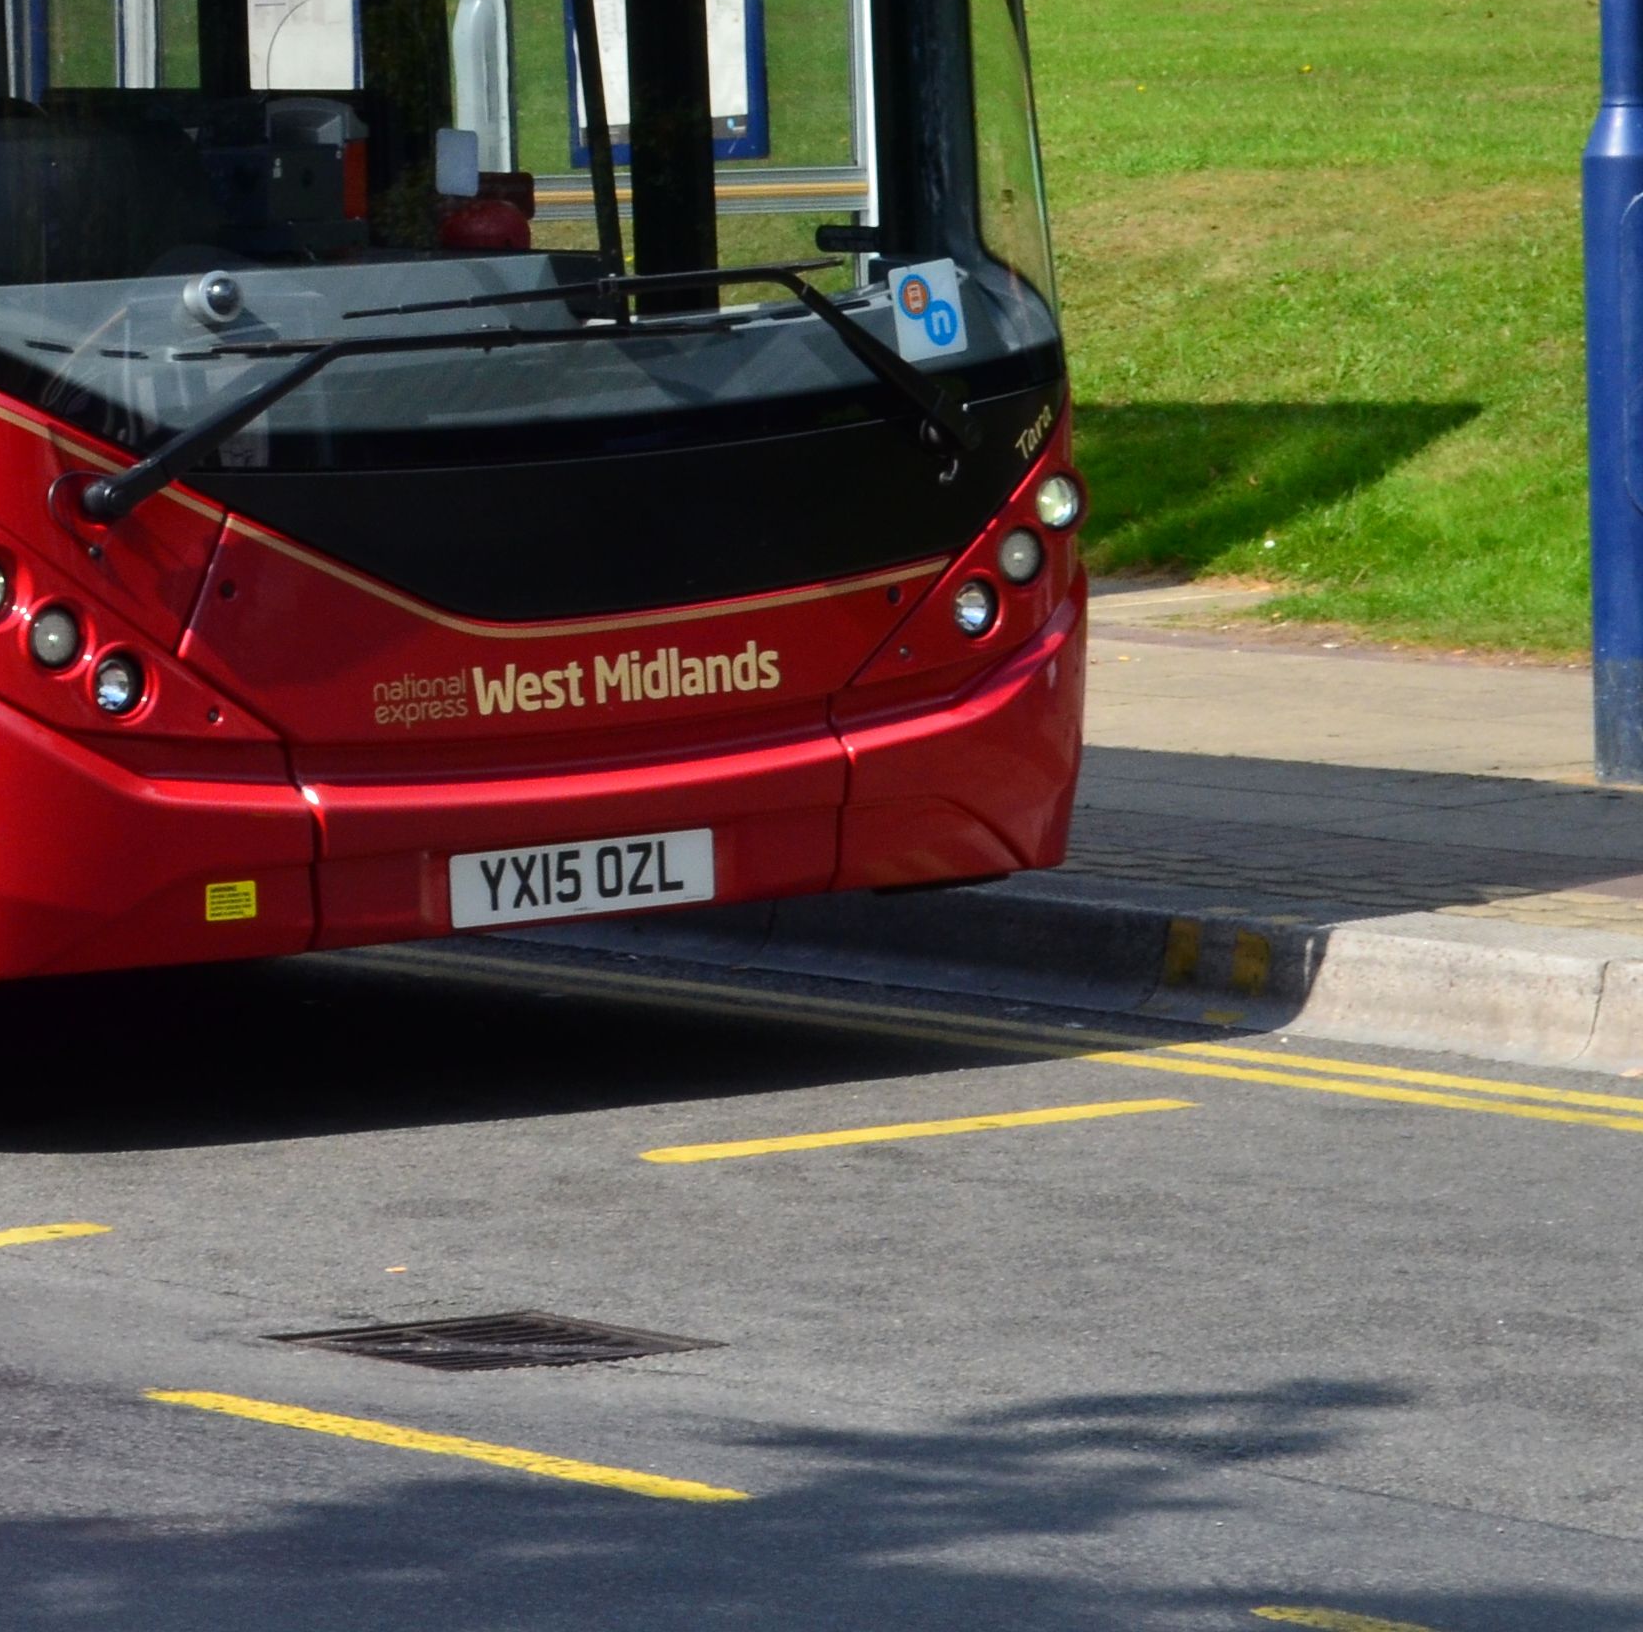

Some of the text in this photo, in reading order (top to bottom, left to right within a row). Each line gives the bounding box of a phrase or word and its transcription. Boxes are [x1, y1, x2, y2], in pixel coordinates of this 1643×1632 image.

[1015, 404, 1053, 460] Tara
[373, 669, 467, 701] national
[473, 641, 780, 715] West Midlands
[374, 696, 469, 728] express
[480, 841, 684, 911] YX15 OZL
